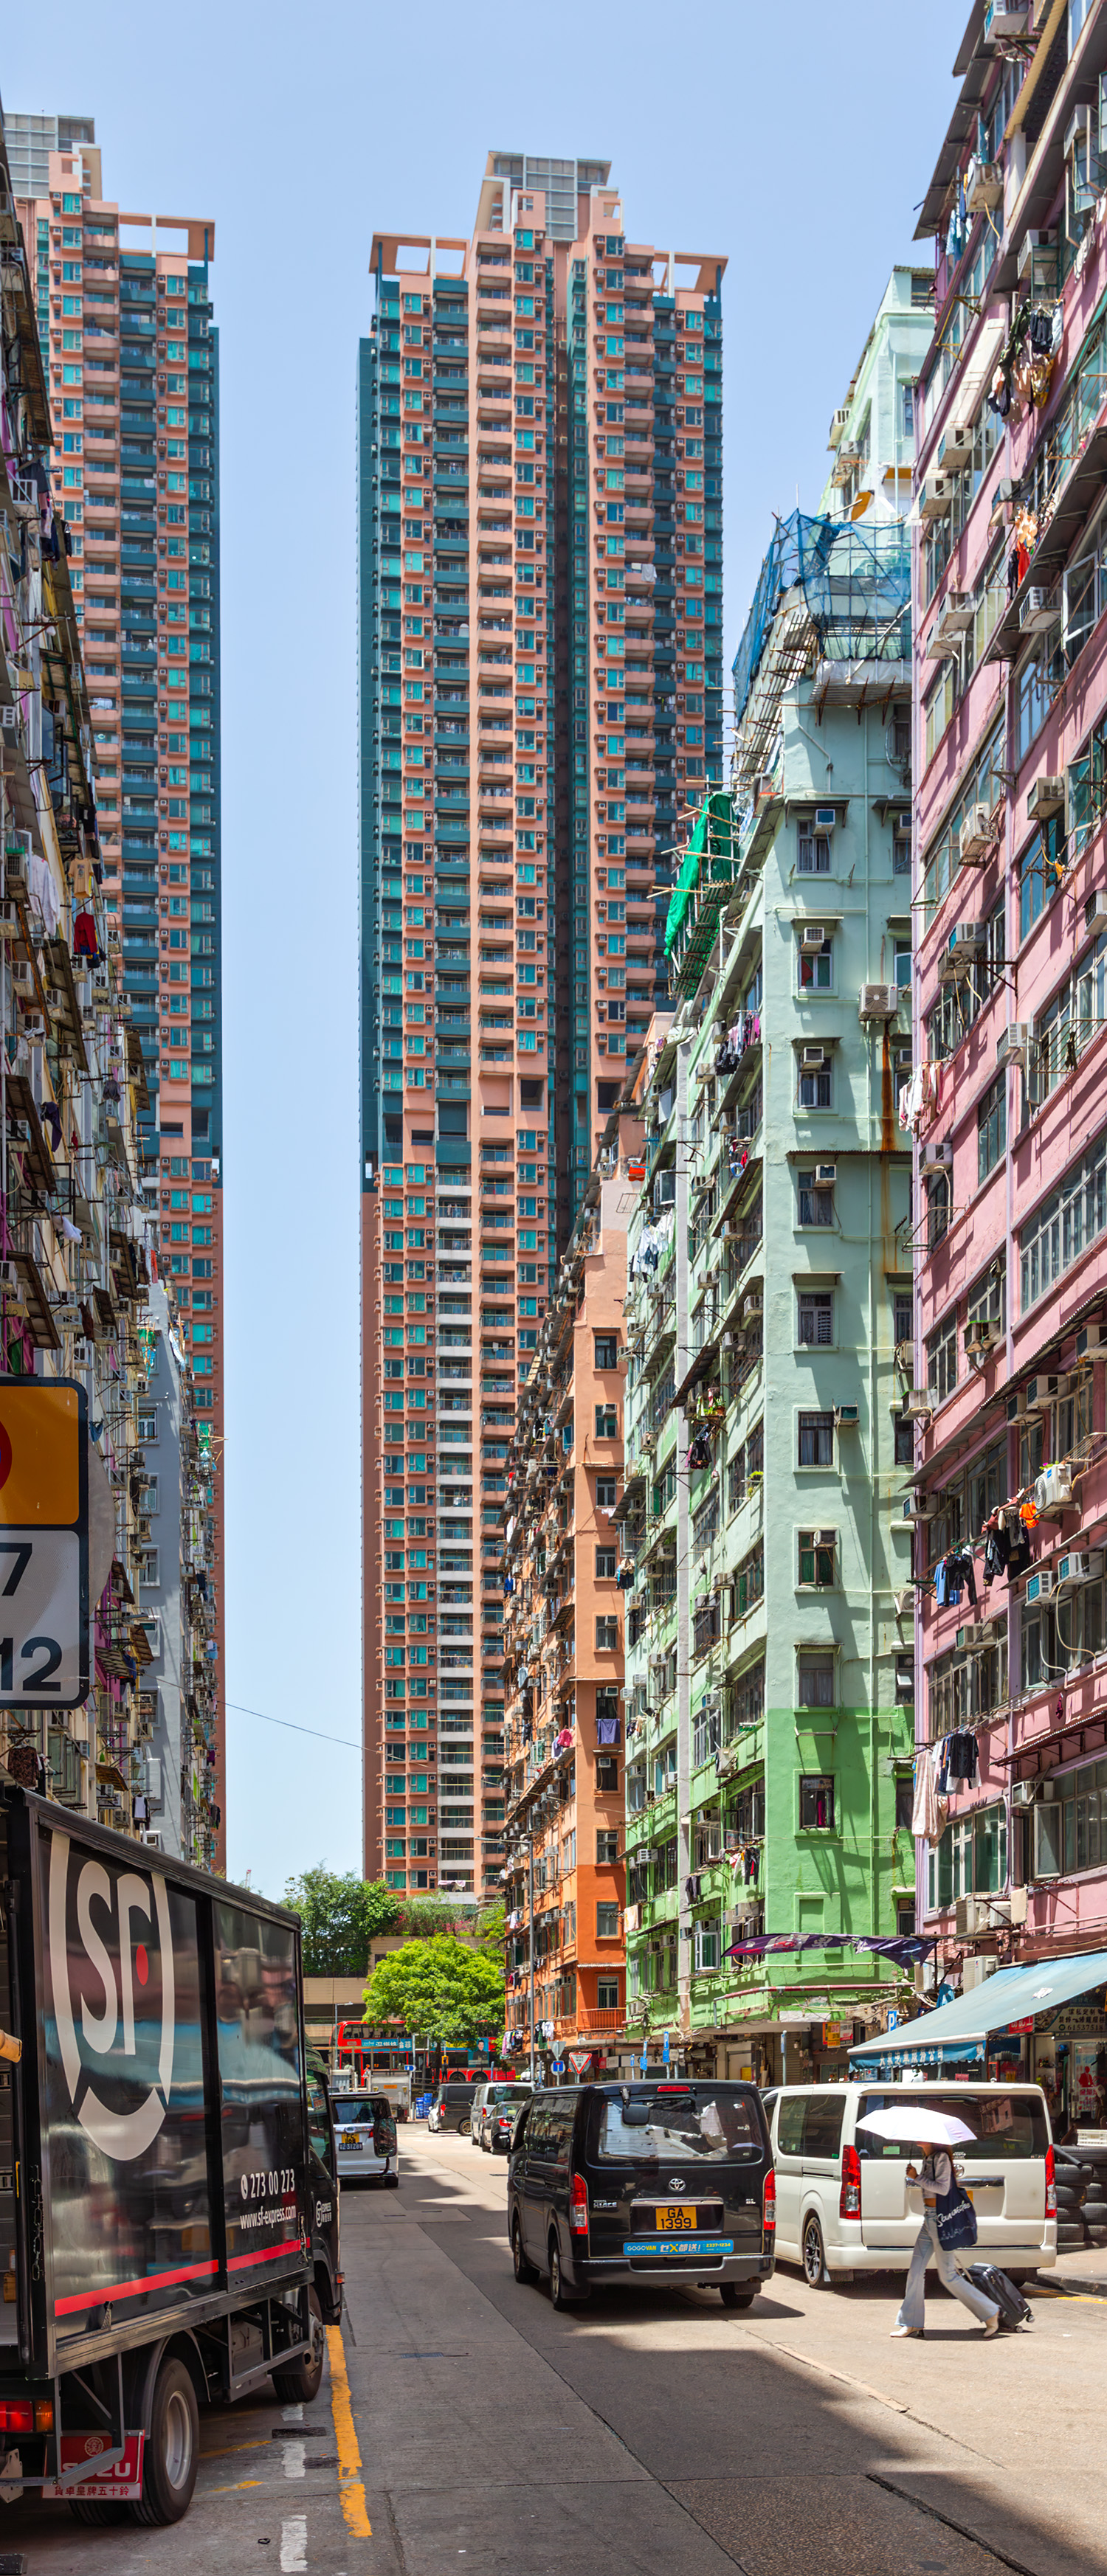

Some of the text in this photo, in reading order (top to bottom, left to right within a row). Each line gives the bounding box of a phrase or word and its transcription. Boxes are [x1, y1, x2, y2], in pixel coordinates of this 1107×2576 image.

[889, 2013, 895, 2029] P
[250, 2168, 295, 2198] 273 00 273
[240, 2205, 296, 2230] www.sf-express.com
[667, 2208, 685, 2218] GA
[661, 2217, 692, 2229] 1399
